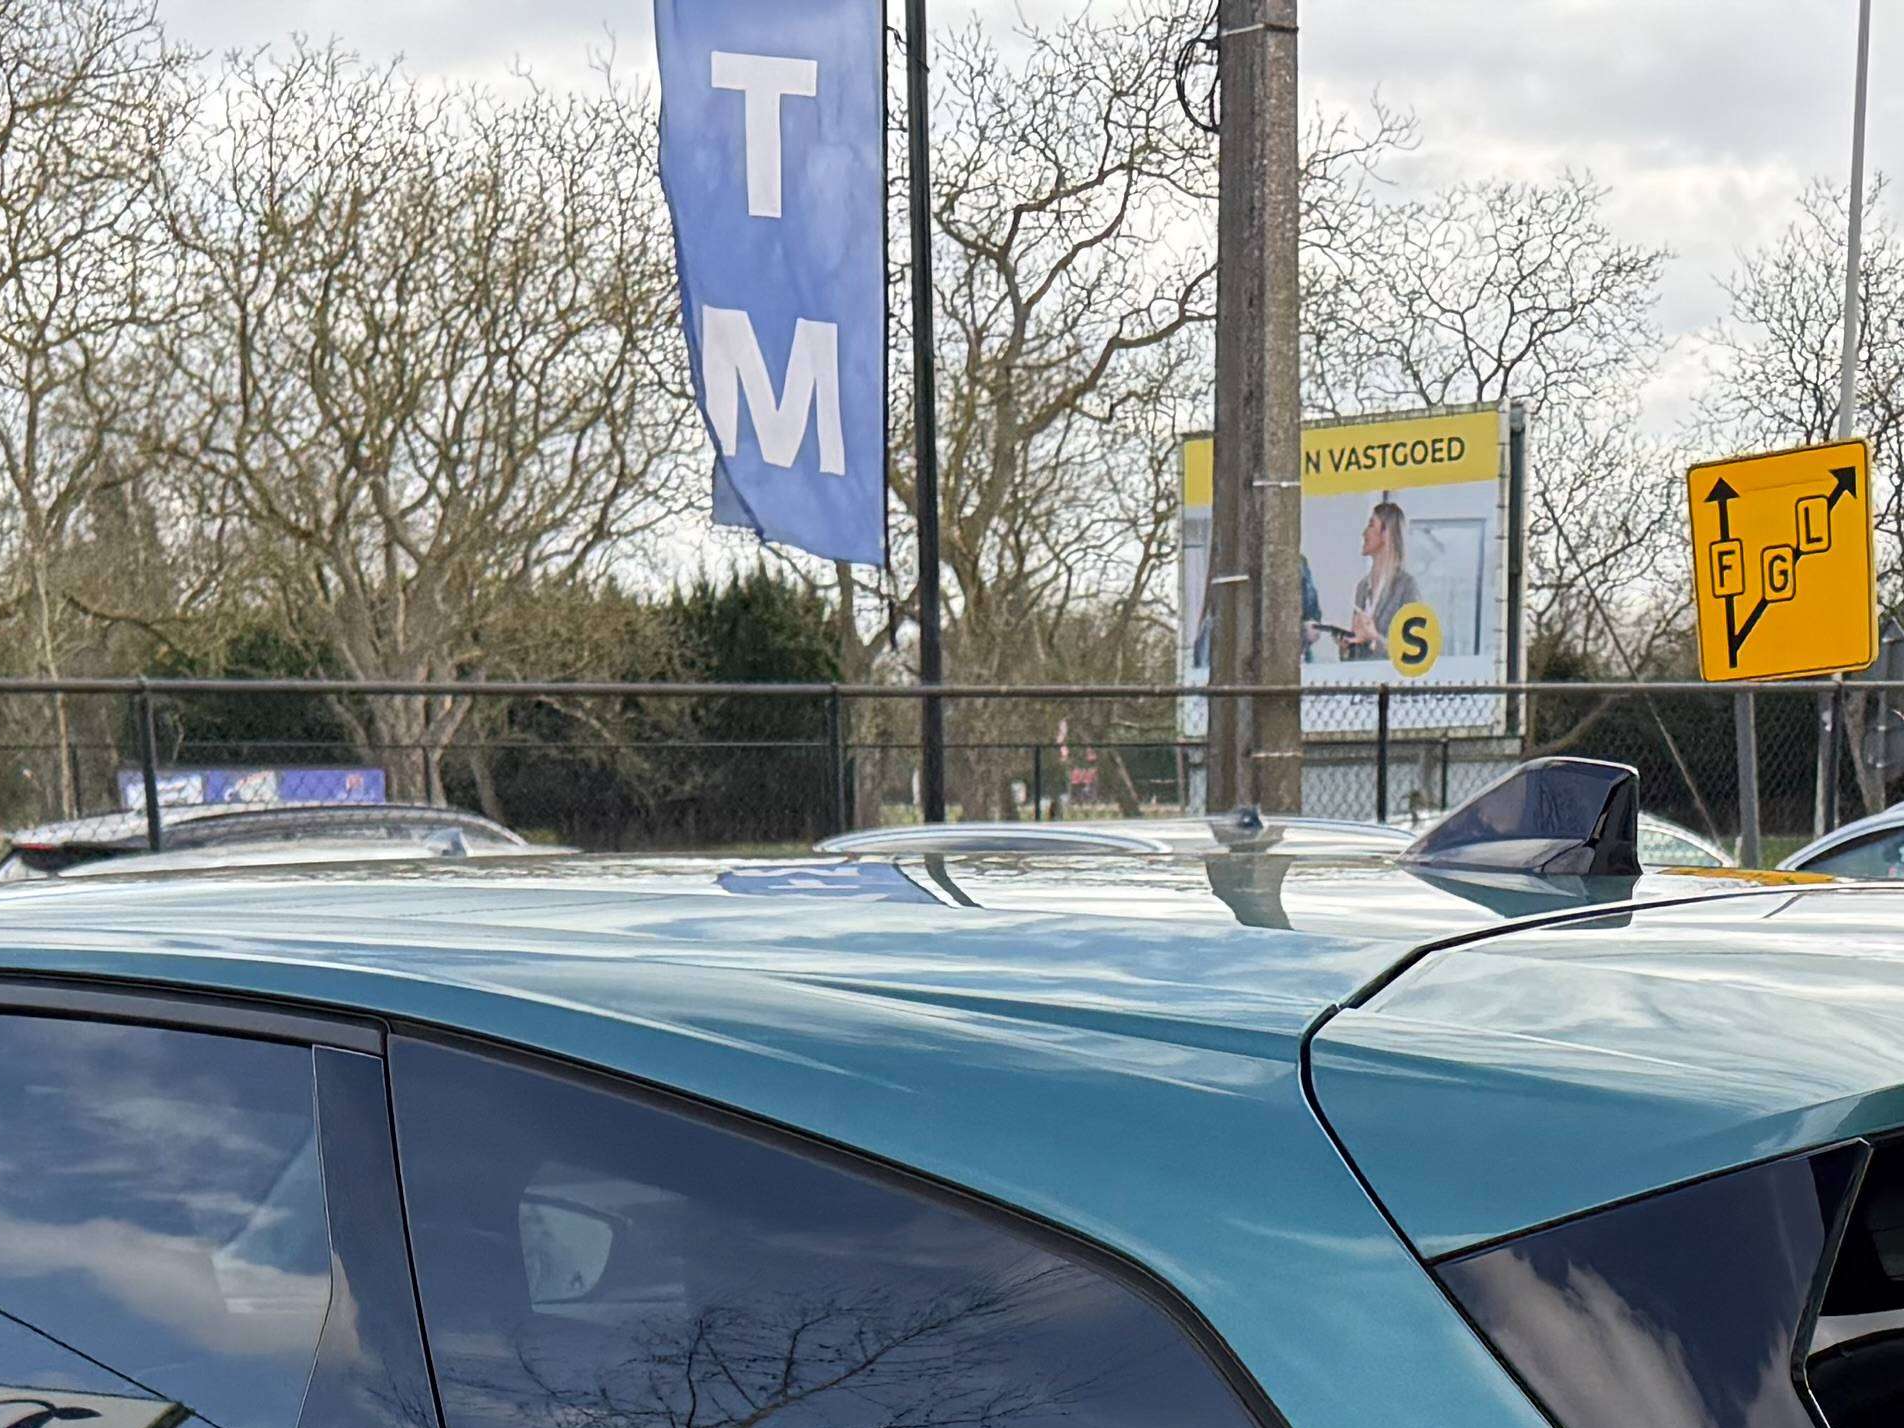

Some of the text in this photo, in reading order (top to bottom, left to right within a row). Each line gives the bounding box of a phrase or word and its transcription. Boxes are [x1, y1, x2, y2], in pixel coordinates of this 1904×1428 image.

[1328, 436, 1465, 473] VASTGOED
[1803, 506, 1823, 544] L
[1717, 550, 1736, 588] F
[1768, 554, 1789, 592] G
[1401, 615, 1430, 665] S
